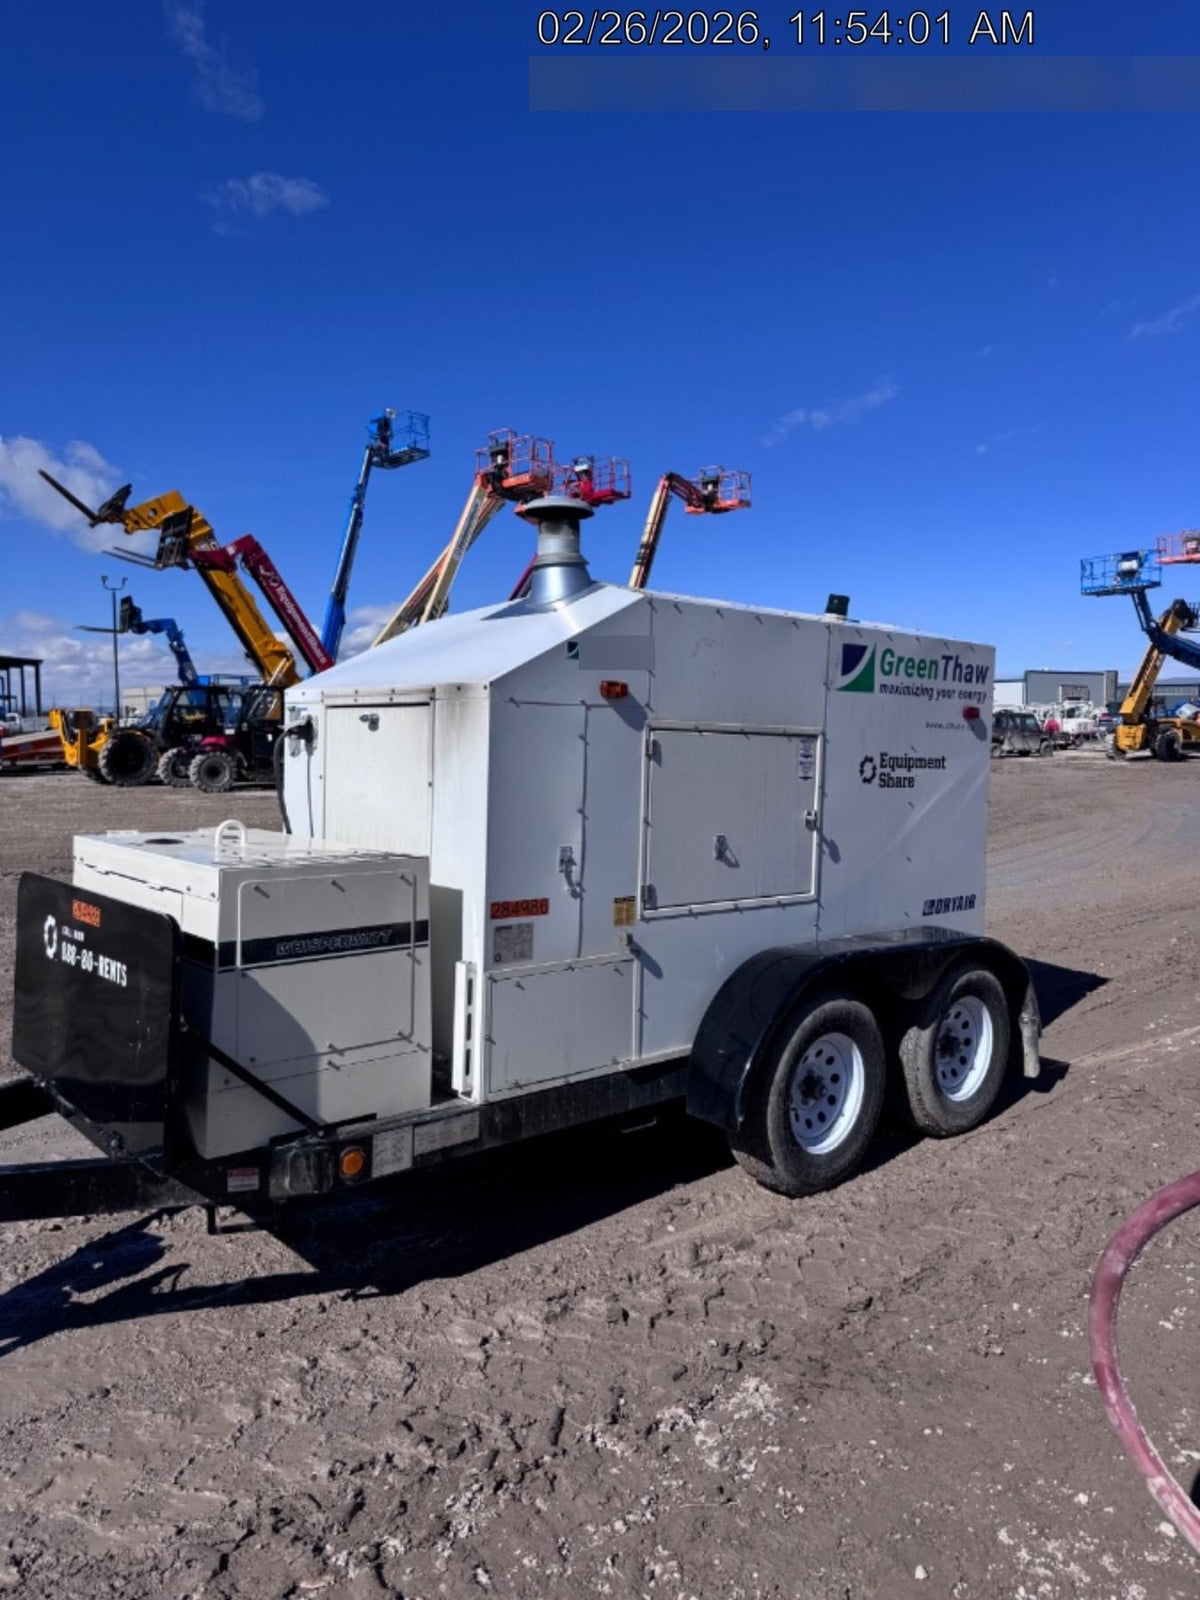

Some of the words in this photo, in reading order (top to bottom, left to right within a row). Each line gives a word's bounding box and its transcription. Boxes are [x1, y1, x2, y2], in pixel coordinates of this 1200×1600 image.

[880, 648, 990, 685] GreenThaw
[880, 682, 935, 701] maximizing
[936, 690, 956, 701] your
[958, 690, 988, 704] energy
[879, 752, 947, 772] Equipment
[878, 773, 915, 788] Share
